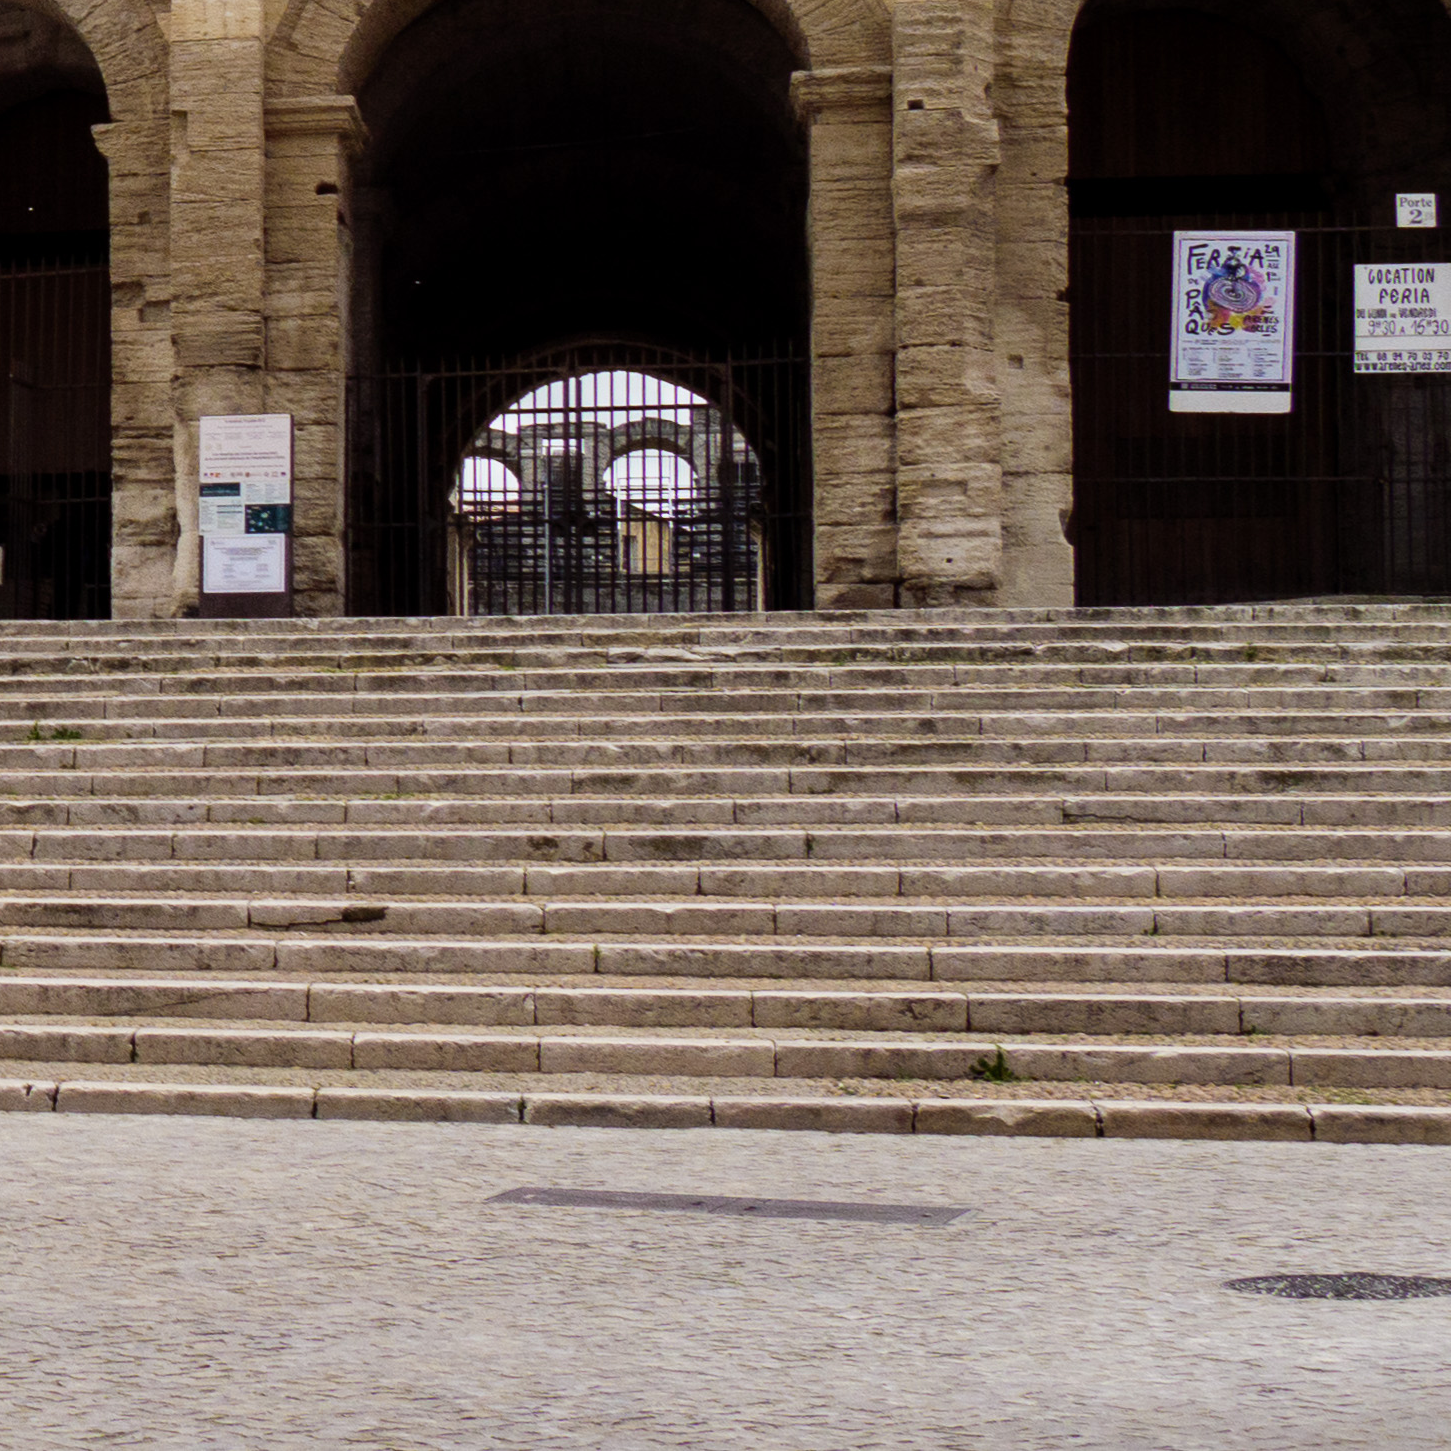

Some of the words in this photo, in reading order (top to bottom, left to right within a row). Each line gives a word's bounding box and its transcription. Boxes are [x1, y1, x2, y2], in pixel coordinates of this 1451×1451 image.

[1399, 196, 1433, 208] Porte
[1409, 208, 1423, 224] 2
[1367, 267, 1435, 284] LOCATION
[1378, 287, 1431, 304] FERIA
